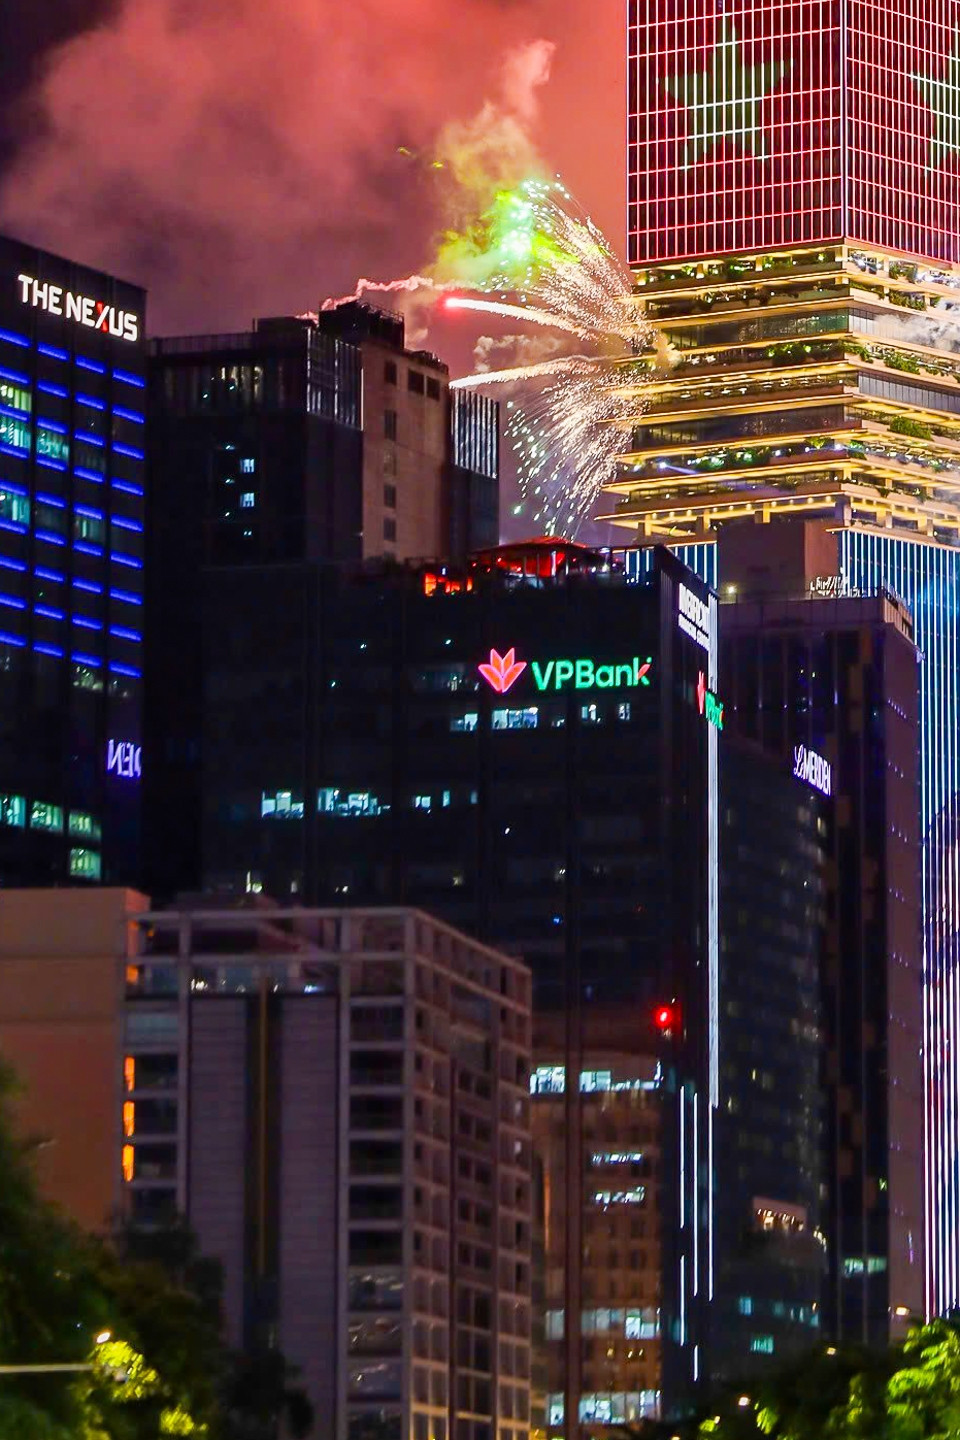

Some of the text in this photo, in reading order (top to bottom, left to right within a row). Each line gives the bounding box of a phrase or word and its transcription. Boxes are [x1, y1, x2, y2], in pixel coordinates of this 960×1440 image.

[18, 274, 138, 342] THE NEXUS
[531, 656, 653, 691] VPBank
